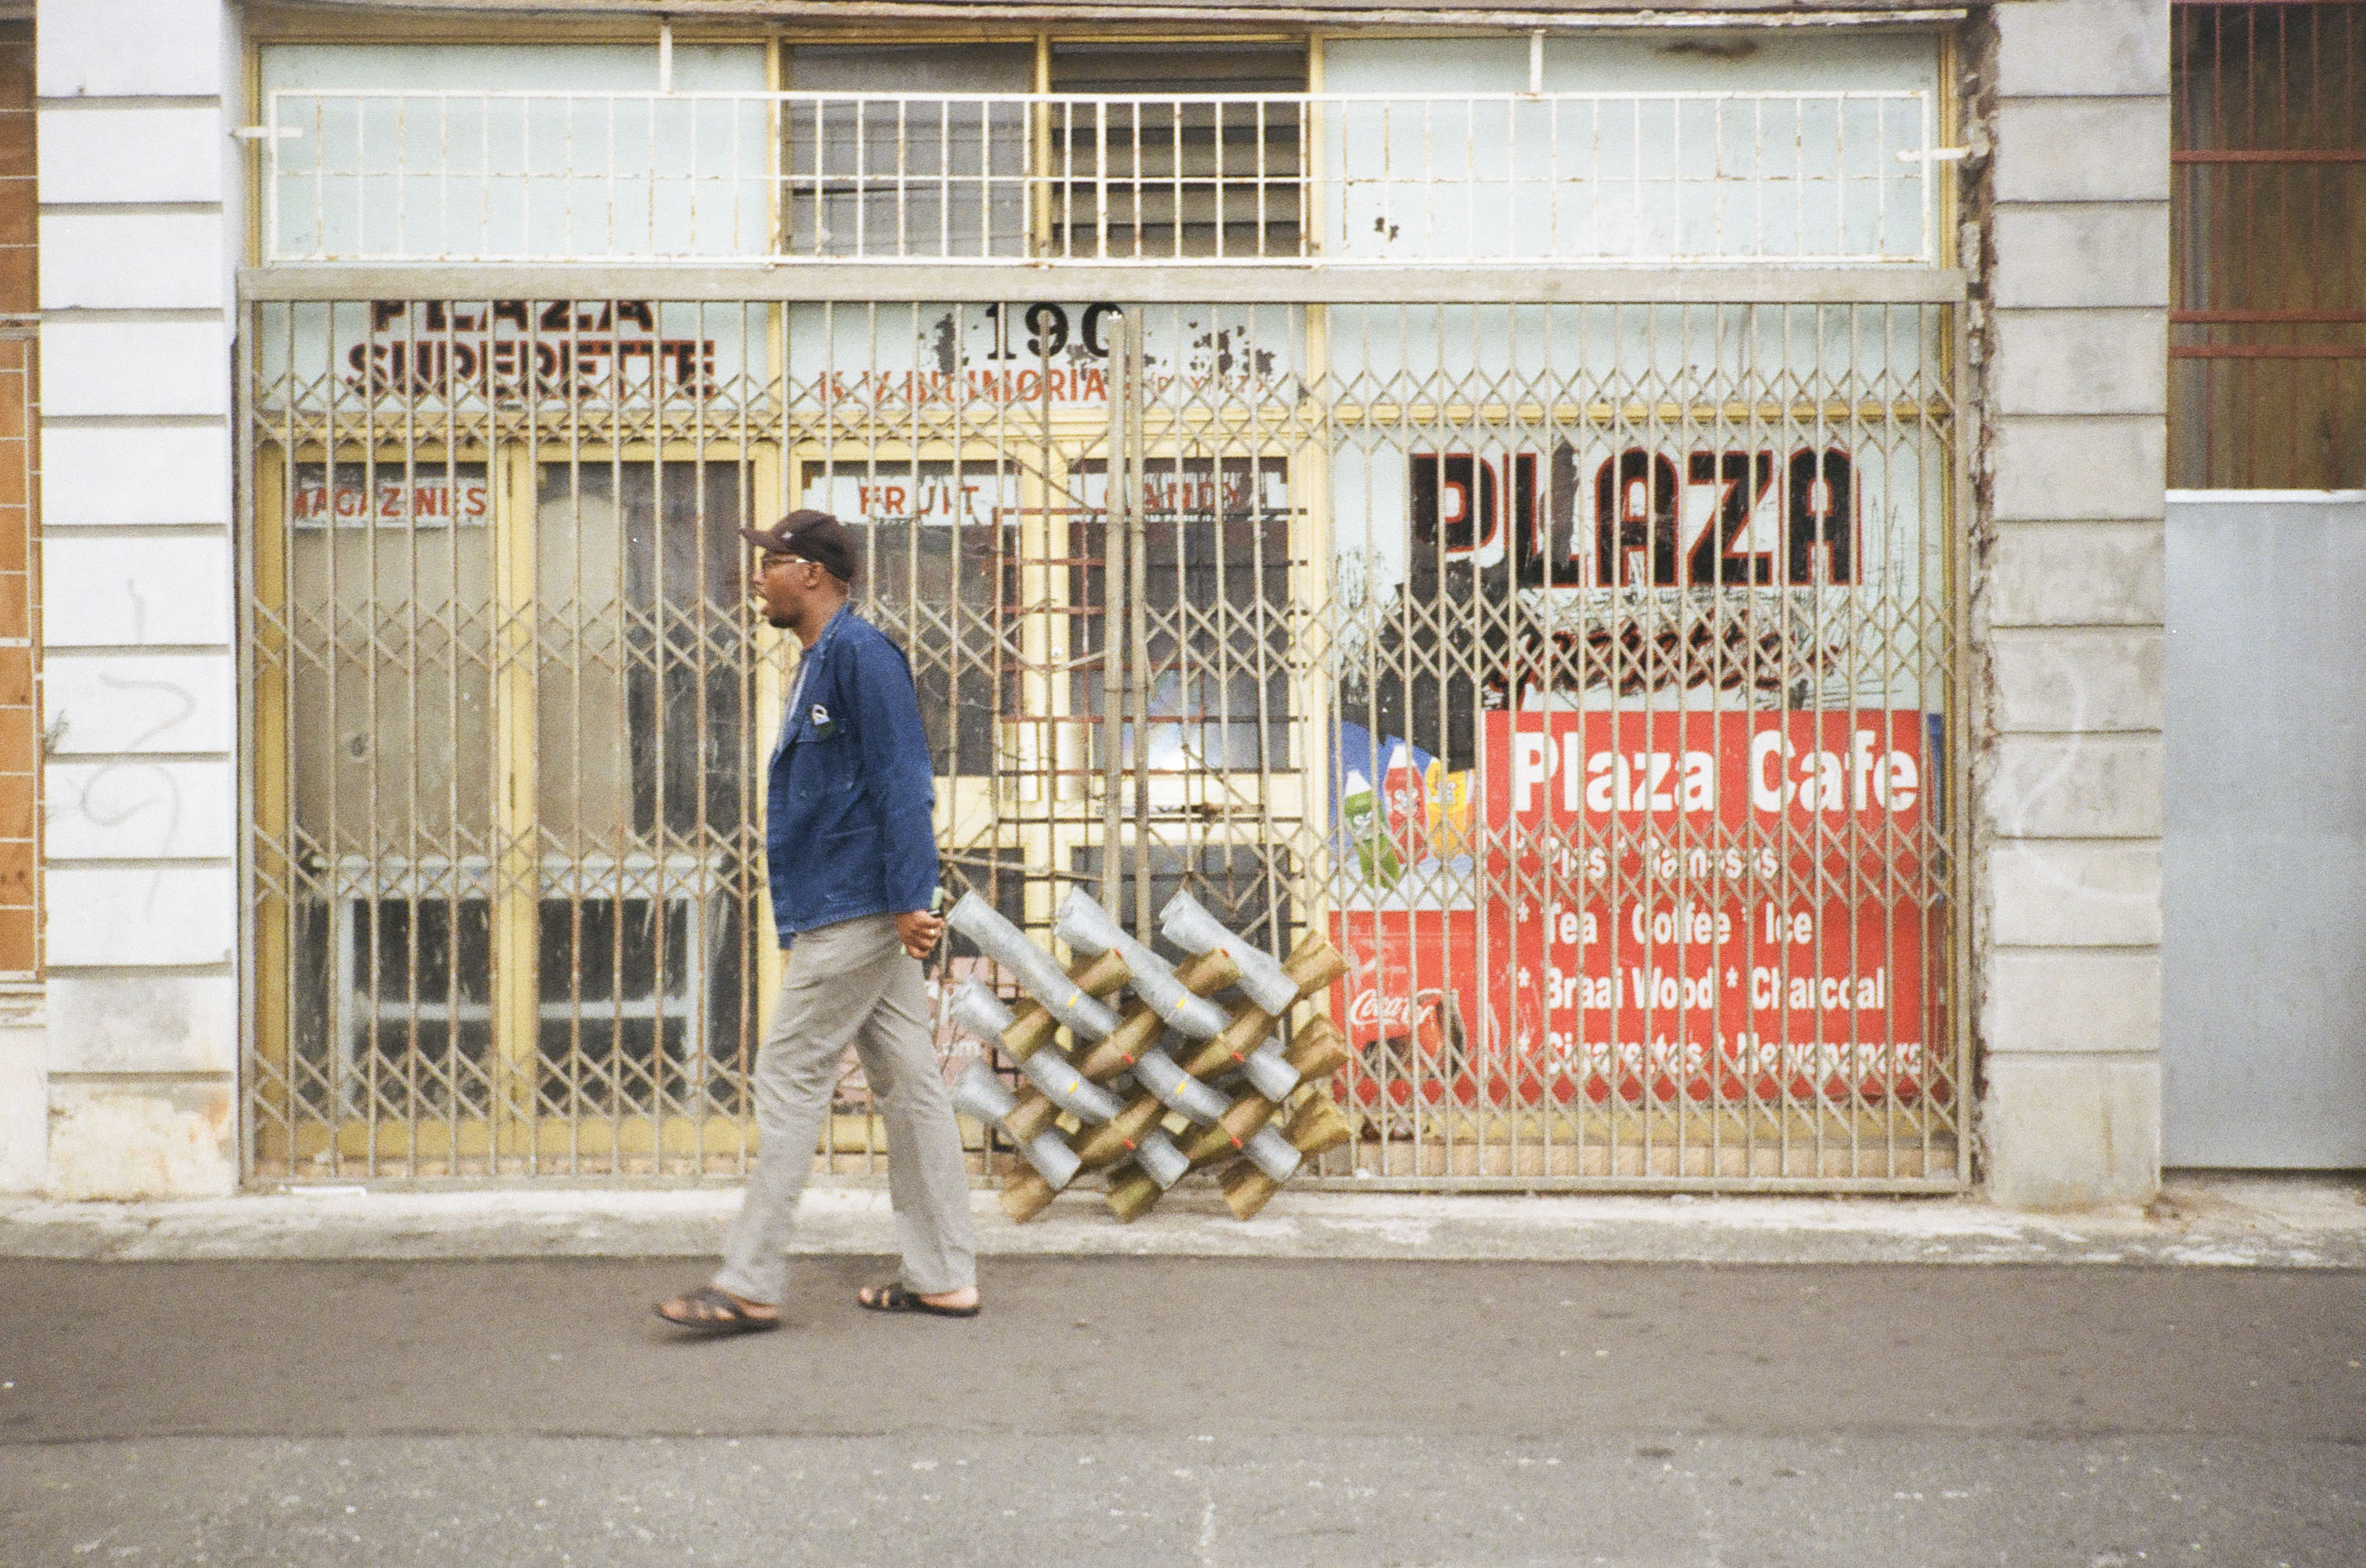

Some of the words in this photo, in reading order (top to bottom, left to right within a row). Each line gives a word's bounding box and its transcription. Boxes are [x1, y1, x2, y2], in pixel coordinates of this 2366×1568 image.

[1409, 446, 1862, 588] PLAZA
[1514, 731, 1714, 813] Plaza
[1751, 729, 1920, 812] Cafe
[1631, 902, 1731, 945] Coffee
[1765, 901, 1812, 945] Ice
[1631, 966, 1714, 1010] Wood
